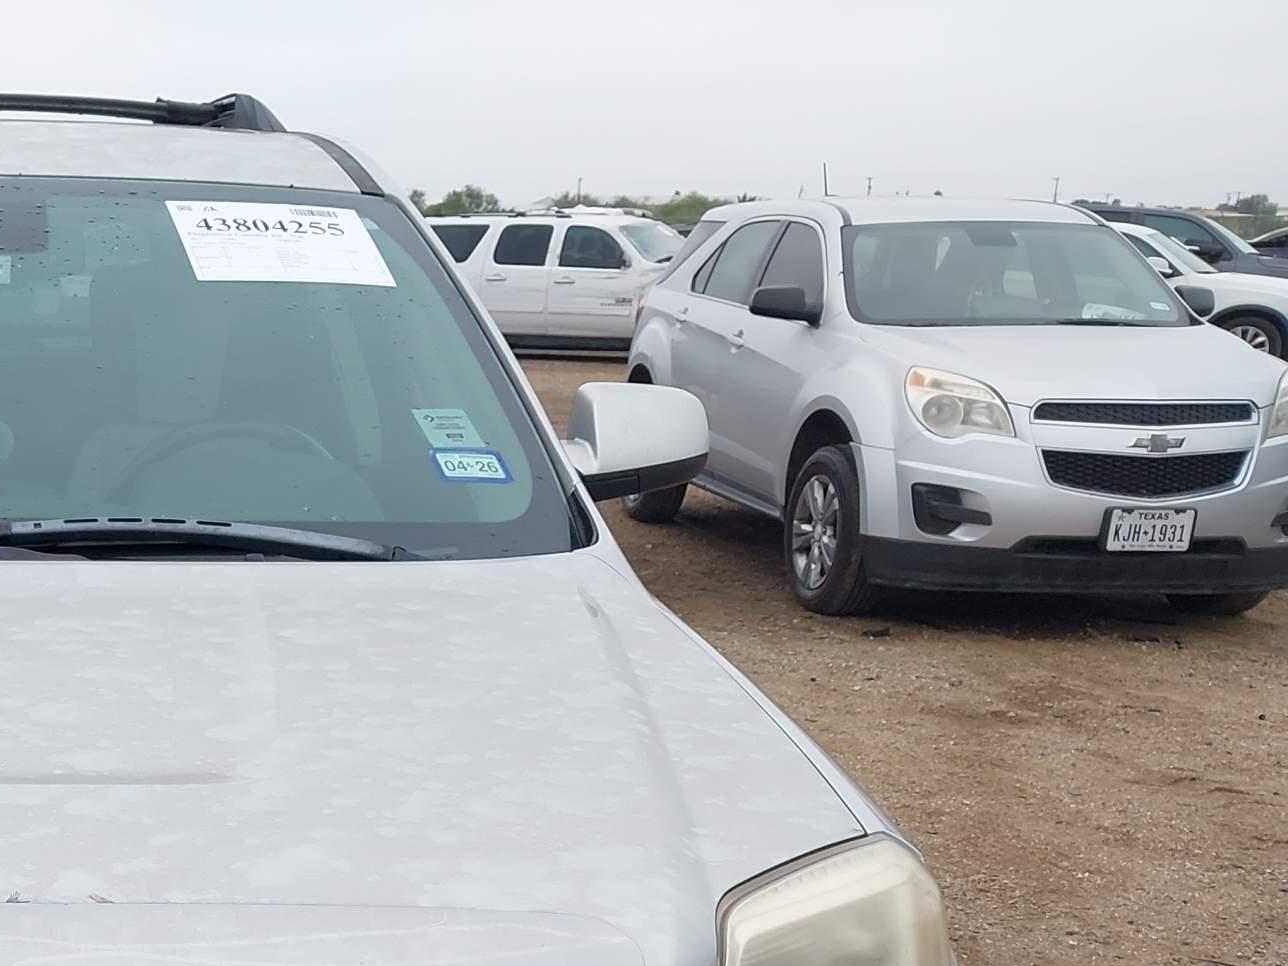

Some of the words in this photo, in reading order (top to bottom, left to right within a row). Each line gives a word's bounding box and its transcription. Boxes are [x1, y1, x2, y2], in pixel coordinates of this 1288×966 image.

[196, 217, 345, 236] 43804255
[444, 459, 468, 472] 04
[475, 460, 498, 473] 26
[1138, 511, 1170, 521] TEXAS
